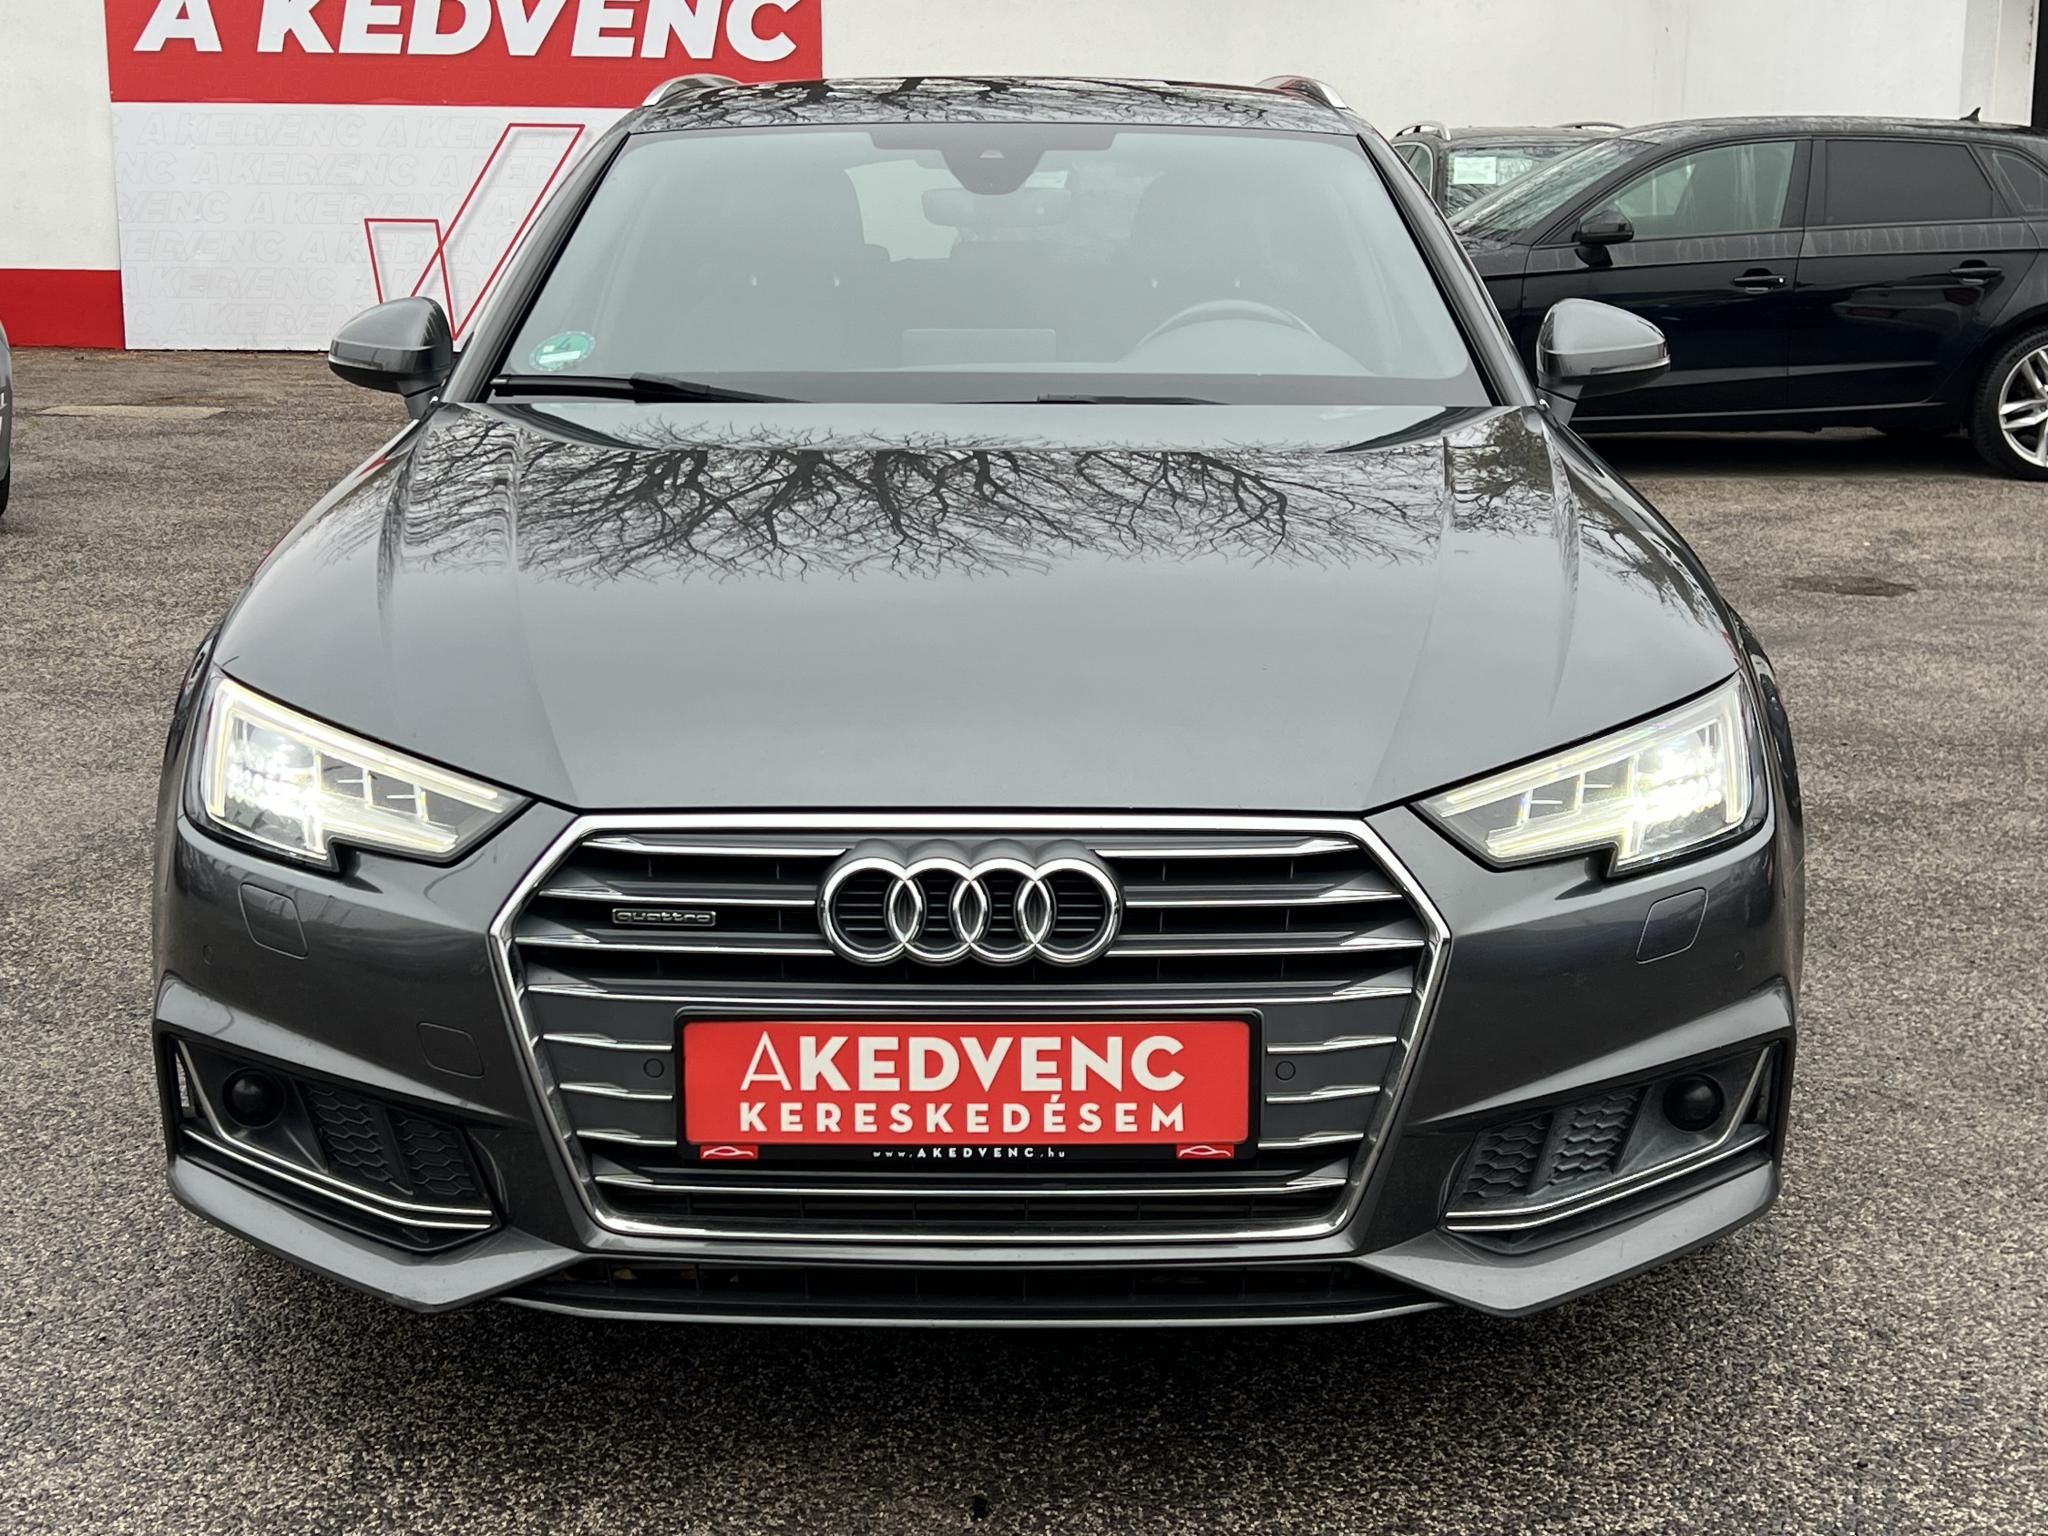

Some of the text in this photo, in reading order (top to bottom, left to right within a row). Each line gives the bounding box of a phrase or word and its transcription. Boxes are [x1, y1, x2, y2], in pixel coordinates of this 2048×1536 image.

[133, 0, 800, 62] A KEDVENC
[616, 910, 711, 924] quattro
[740, 1094, 1185, 1133] KERESKEDÉSEM
[873, 1147, 1066, 1158] www.AKEDVENC.hu
